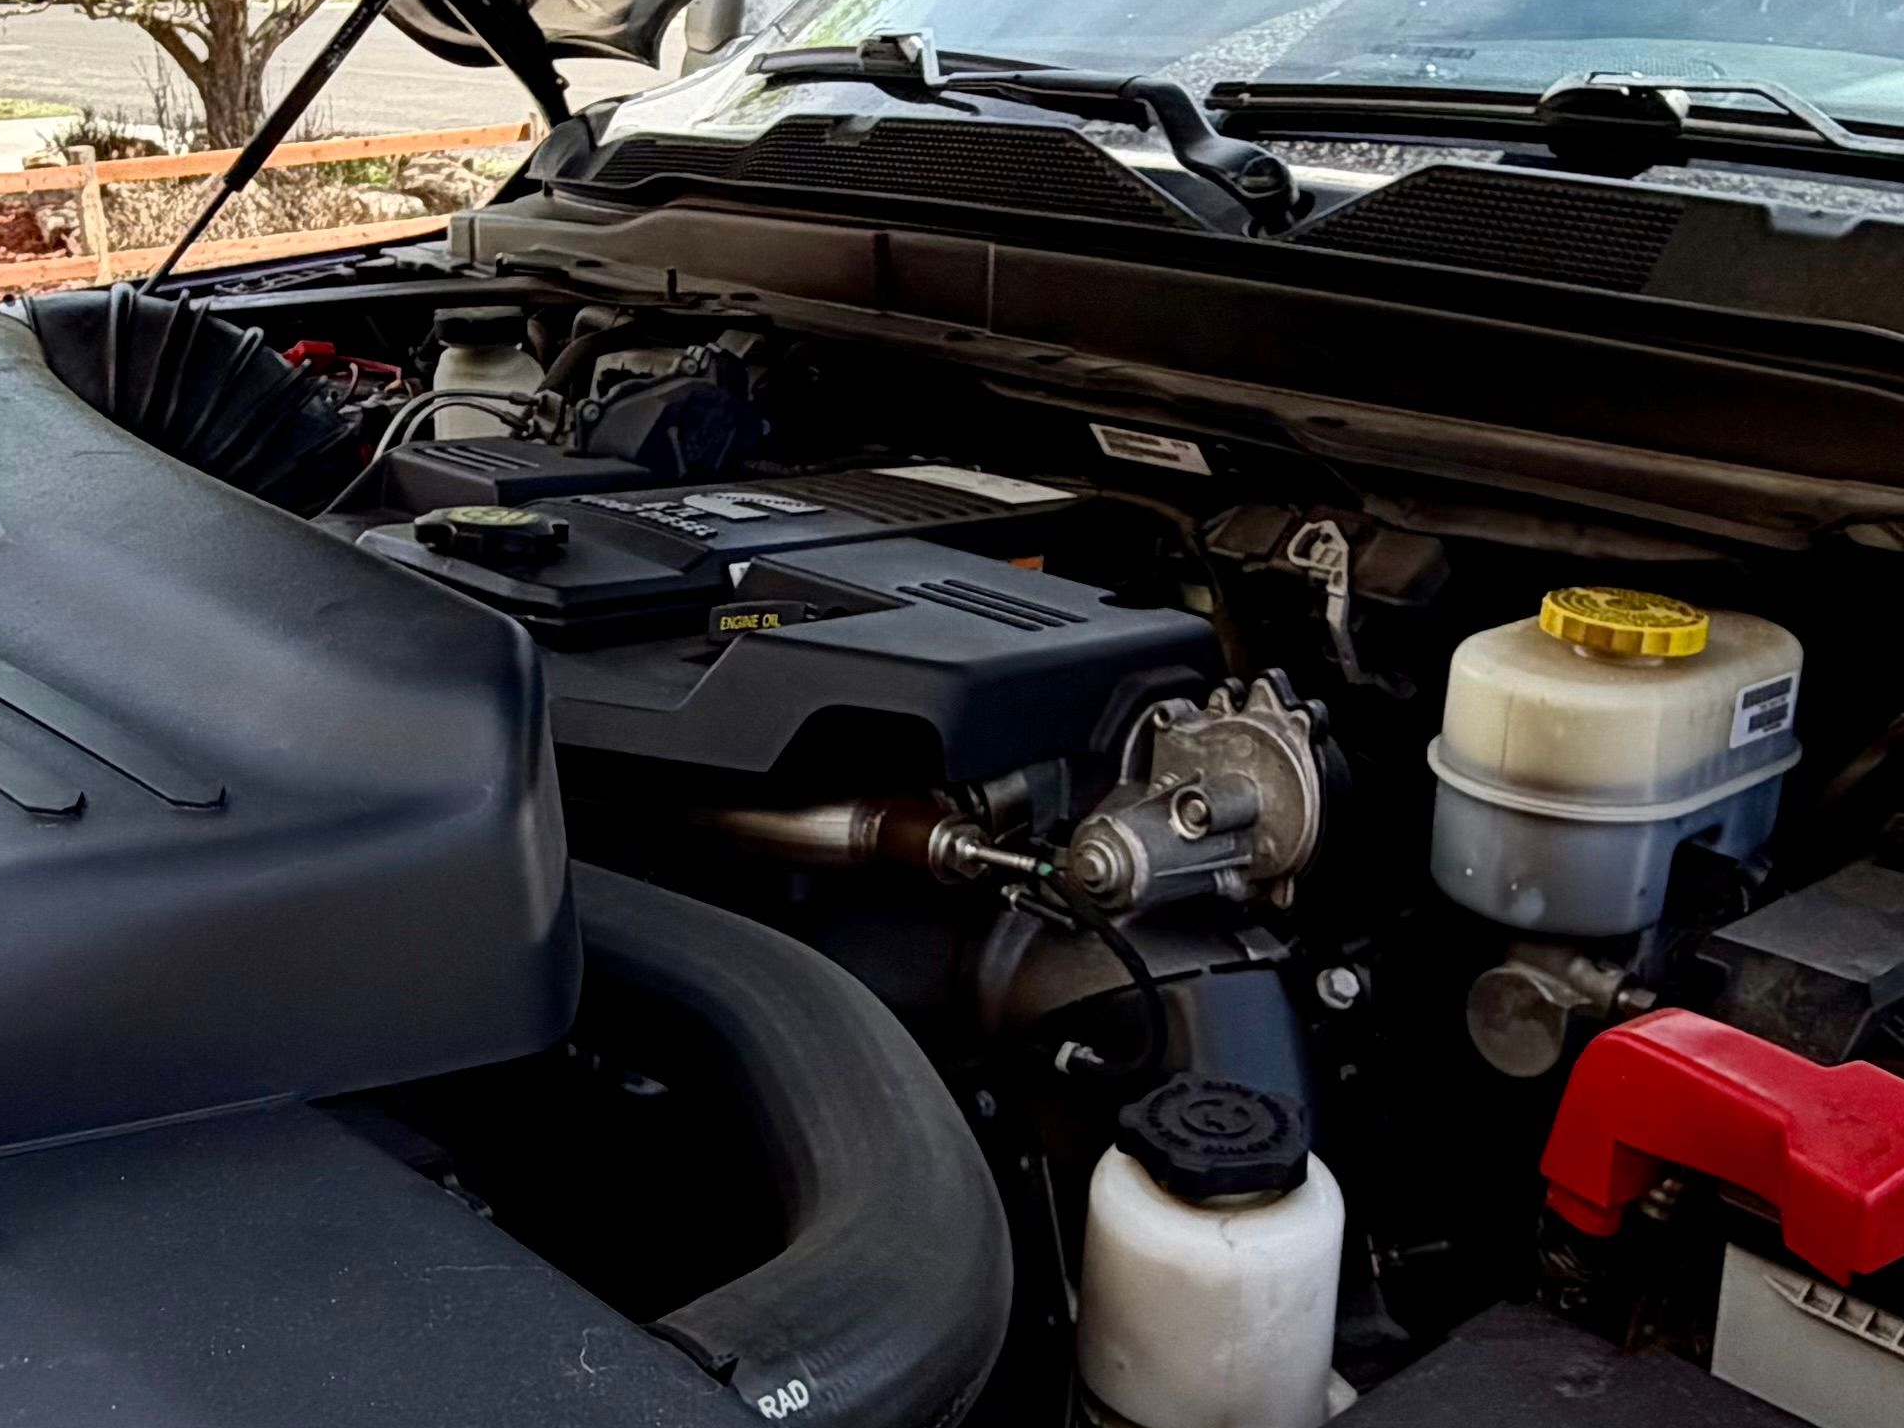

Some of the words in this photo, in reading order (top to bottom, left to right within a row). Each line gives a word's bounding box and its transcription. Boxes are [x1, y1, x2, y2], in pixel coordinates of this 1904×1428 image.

[720, 613, 760, 630] ENGINE
[761, 612, 782, 628] OIL
[757, 1379, 810, 1420] RAD
